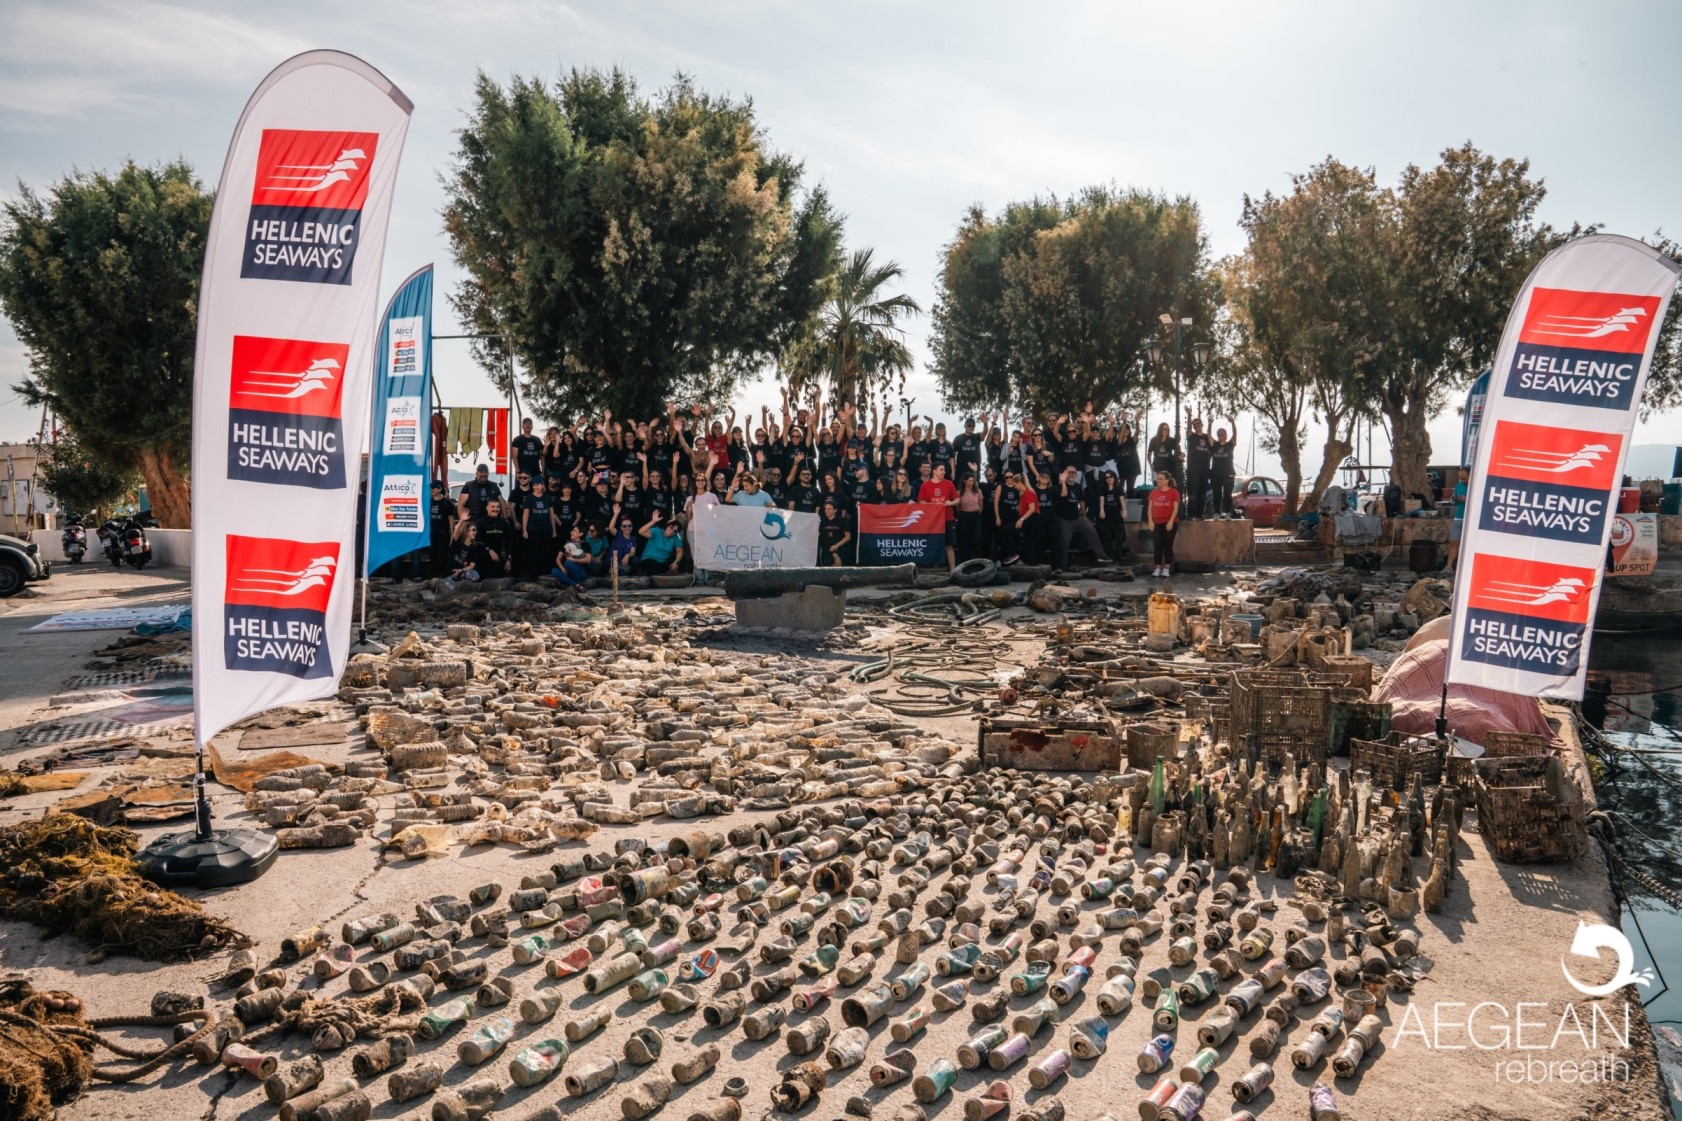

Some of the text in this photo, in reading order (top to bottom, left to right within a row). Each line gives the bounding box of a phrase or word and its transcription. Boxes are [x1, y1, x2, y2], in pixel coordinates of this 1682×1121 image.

[251, 220, 354, 246] HELLENIC
[253, 244, 343, 270] SEAWAYS
[1516, 354, 1634, 381] HELLENIC
[1520, 373, 1620, 398] SEAWAYS
[233, 423, 336, 453] HELLENIC
[239, 448, 329, 475] SEAWAYS
[1489, 486, 1602, 516] HELLENIC
[1493, 506, 1590, 533] SEAWAYS
[714, 544, 783, 562] AEGEAN
[877, 539, 927, 549] HELLENIC
[880, 548, 924, 557] SEAWAYS
[1629, 563, 1650, 571] SPOT
[229, 617, 322, 646] HELLENIC
[1470, 618, 1579, 648] HELLENIC
[237, 640, 316, 667] SEAWAYS
[1475, 637, 1569, 666] SEAWAYS
